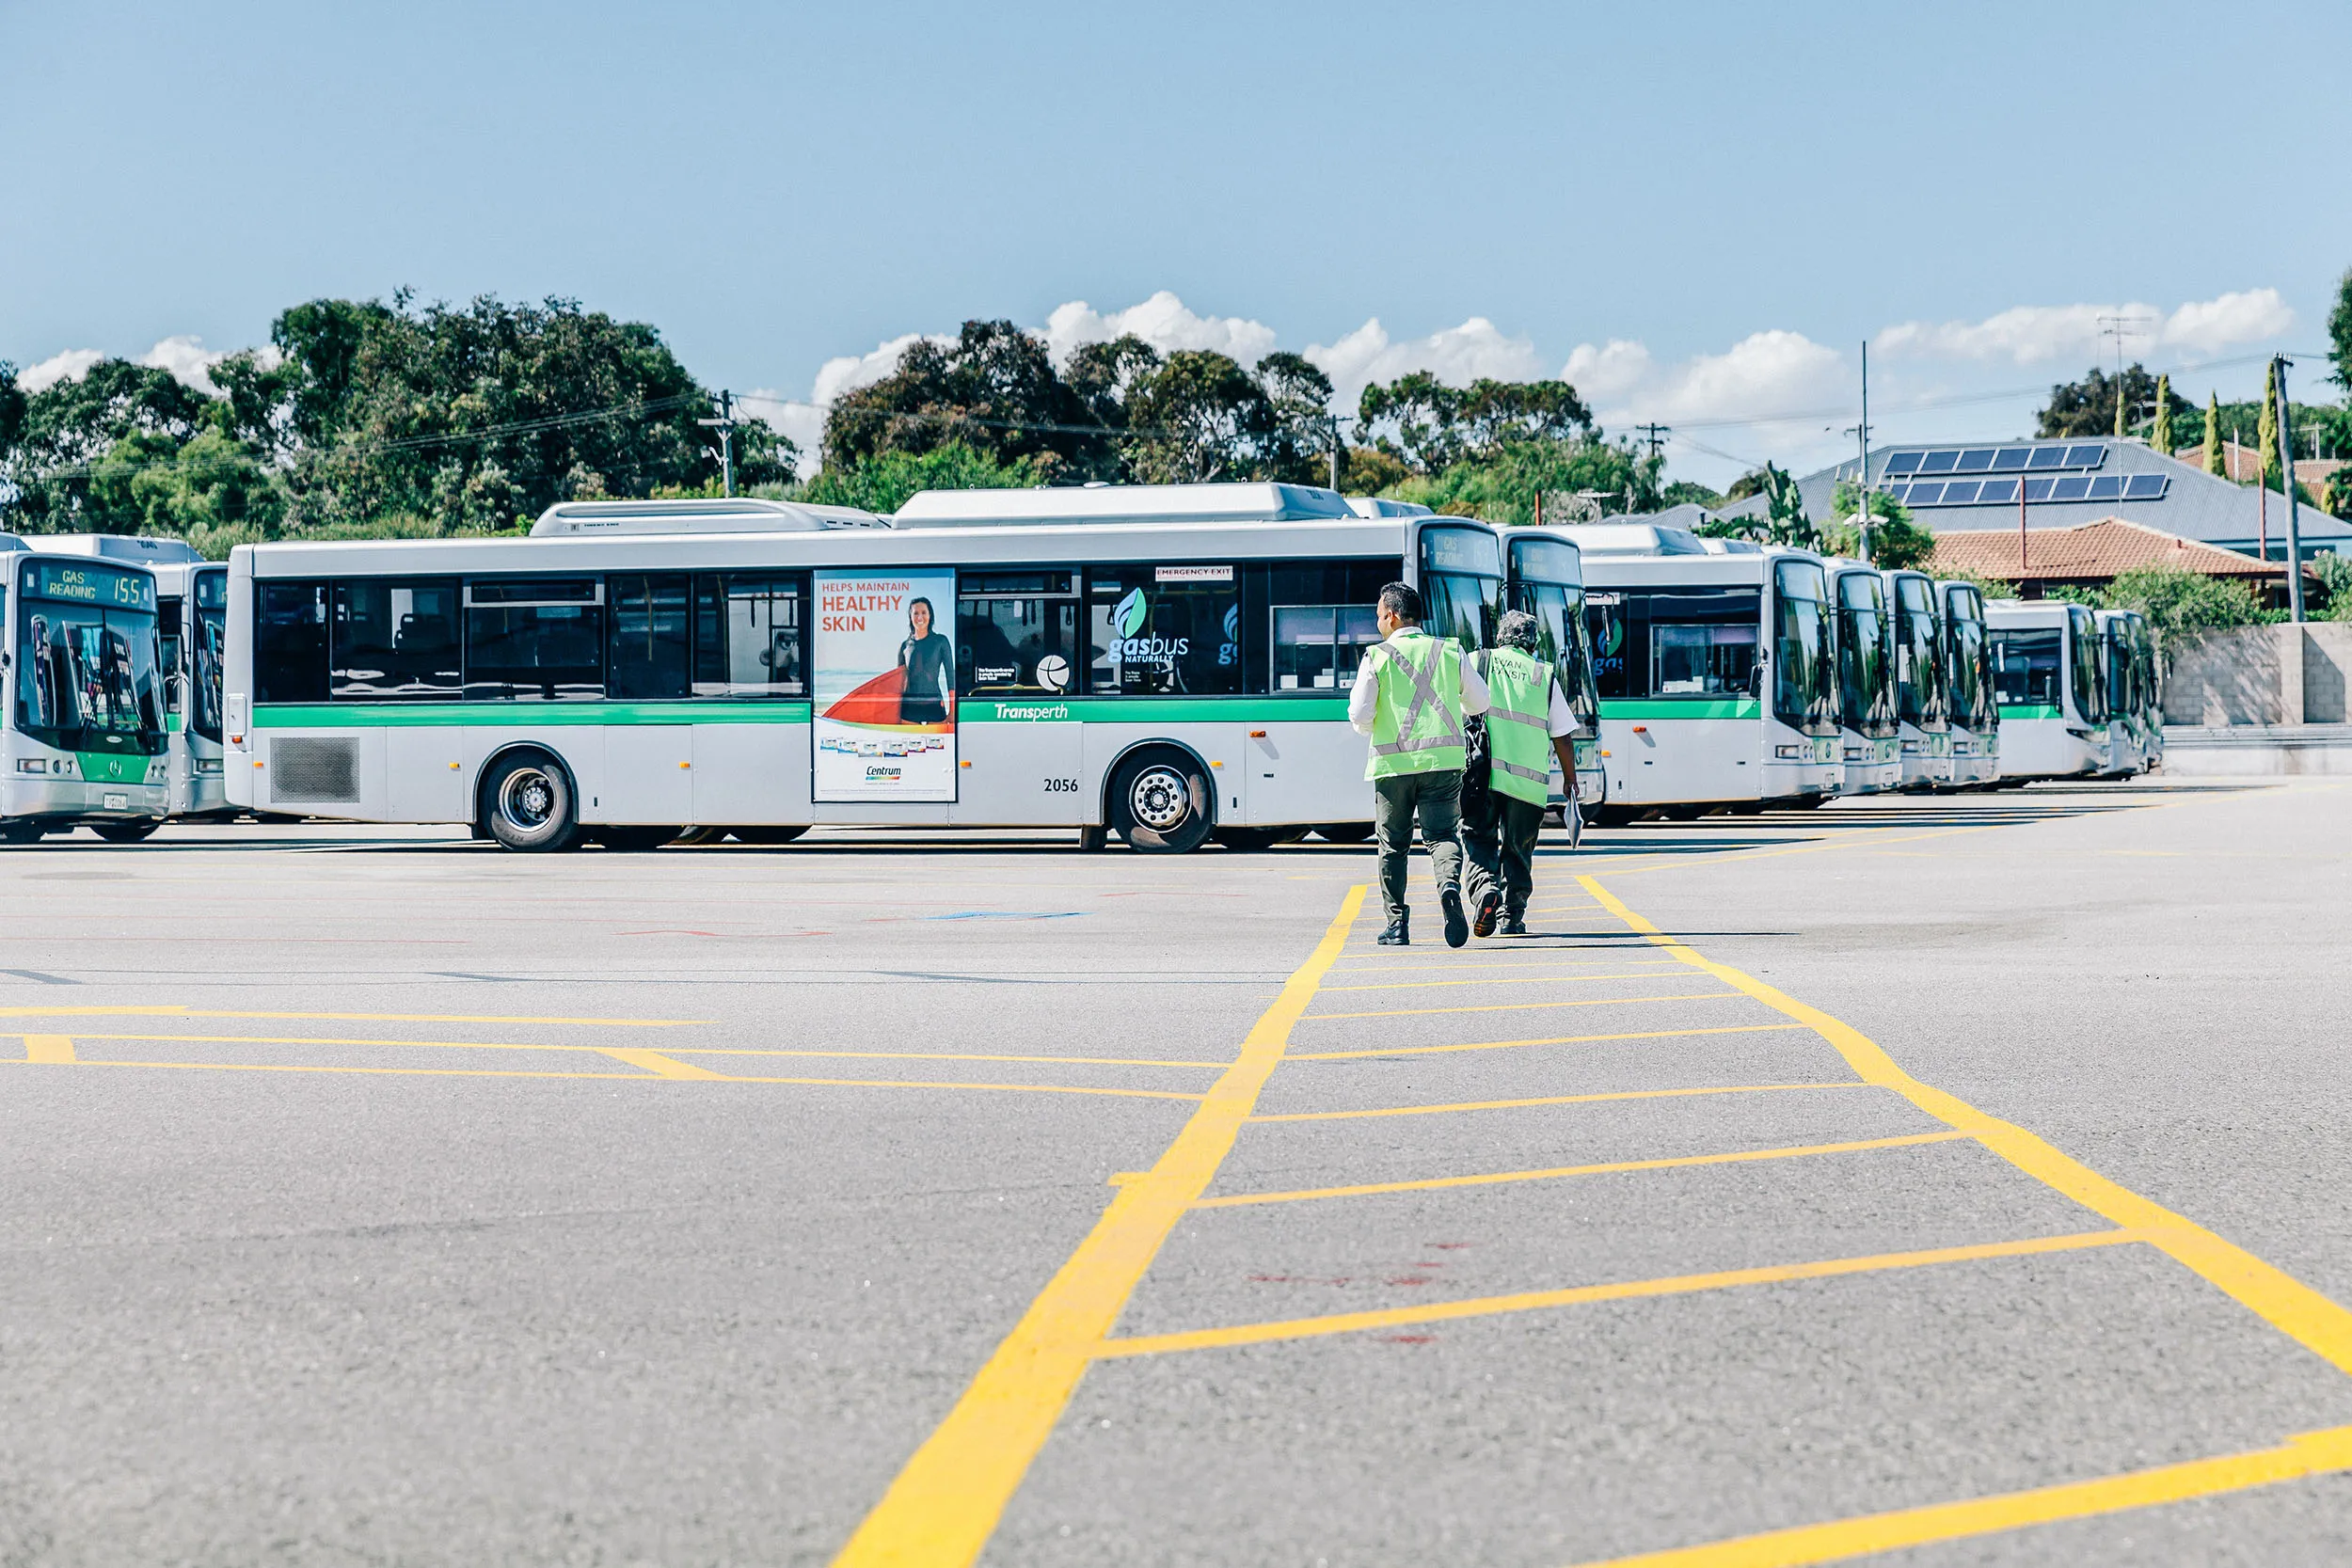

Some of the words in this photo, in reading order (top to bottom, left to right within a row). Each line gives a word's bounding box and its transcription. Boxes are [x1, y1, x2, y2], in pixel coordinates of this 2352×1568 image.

[62, 570, 85, 584] GAS
[49, 582, 96, 600] READING
[114, 577, 139, 604] 155
[822, 582, 853, 593] HELPS
[856, 581, 910, 592] MAINTAIN
[822, 595, 902, 611] HEALTHY
[822, 616, 865, 632] SKIN
[1124, 655, 1174, 663] NATURALLY
[994, 703, 1069, 723] Transperth
[866, 766, 902, 776] Centrum
[1043, 778, 1079, 792] 2056
